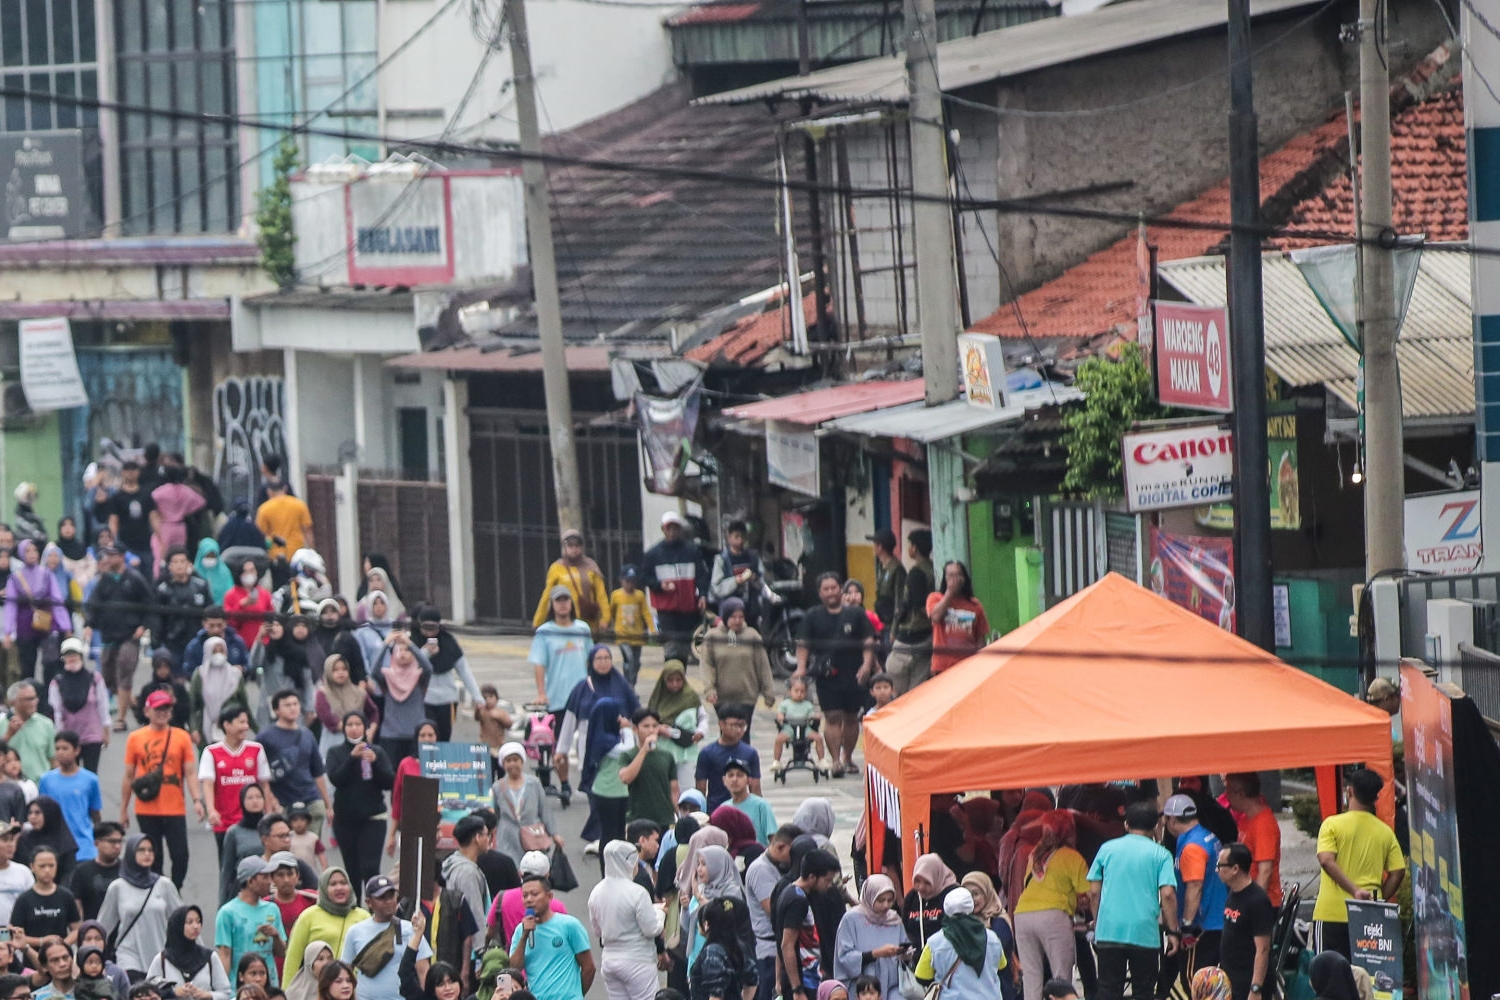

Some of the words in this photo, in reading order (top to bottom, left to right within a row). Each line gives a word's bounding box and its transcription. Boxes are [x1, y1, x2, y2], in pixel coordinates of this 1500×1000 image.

[1163, 318, 1204, 354] WAROENG
[1208, 343, 1220, 378] 48
[1169, 357, 1201, 393] MAKAN
[1133, 433, 1233, 466] Canon
[1136, 475, 1230, 492] imageRUNNE
[1138, 488, 1187, 506] DIGITAL
[1191, 480, 1233, 499] COPIE
[1438, 500, 1480, 542] Z
[473, 761, 486, 770] BNI
[909, 909, 942, 919] wndr
[1363, 924, 1383, 940] rejeki
[1356, 939, 1378, 951] wondr
[1378, 939, 1393, 952] BNI
